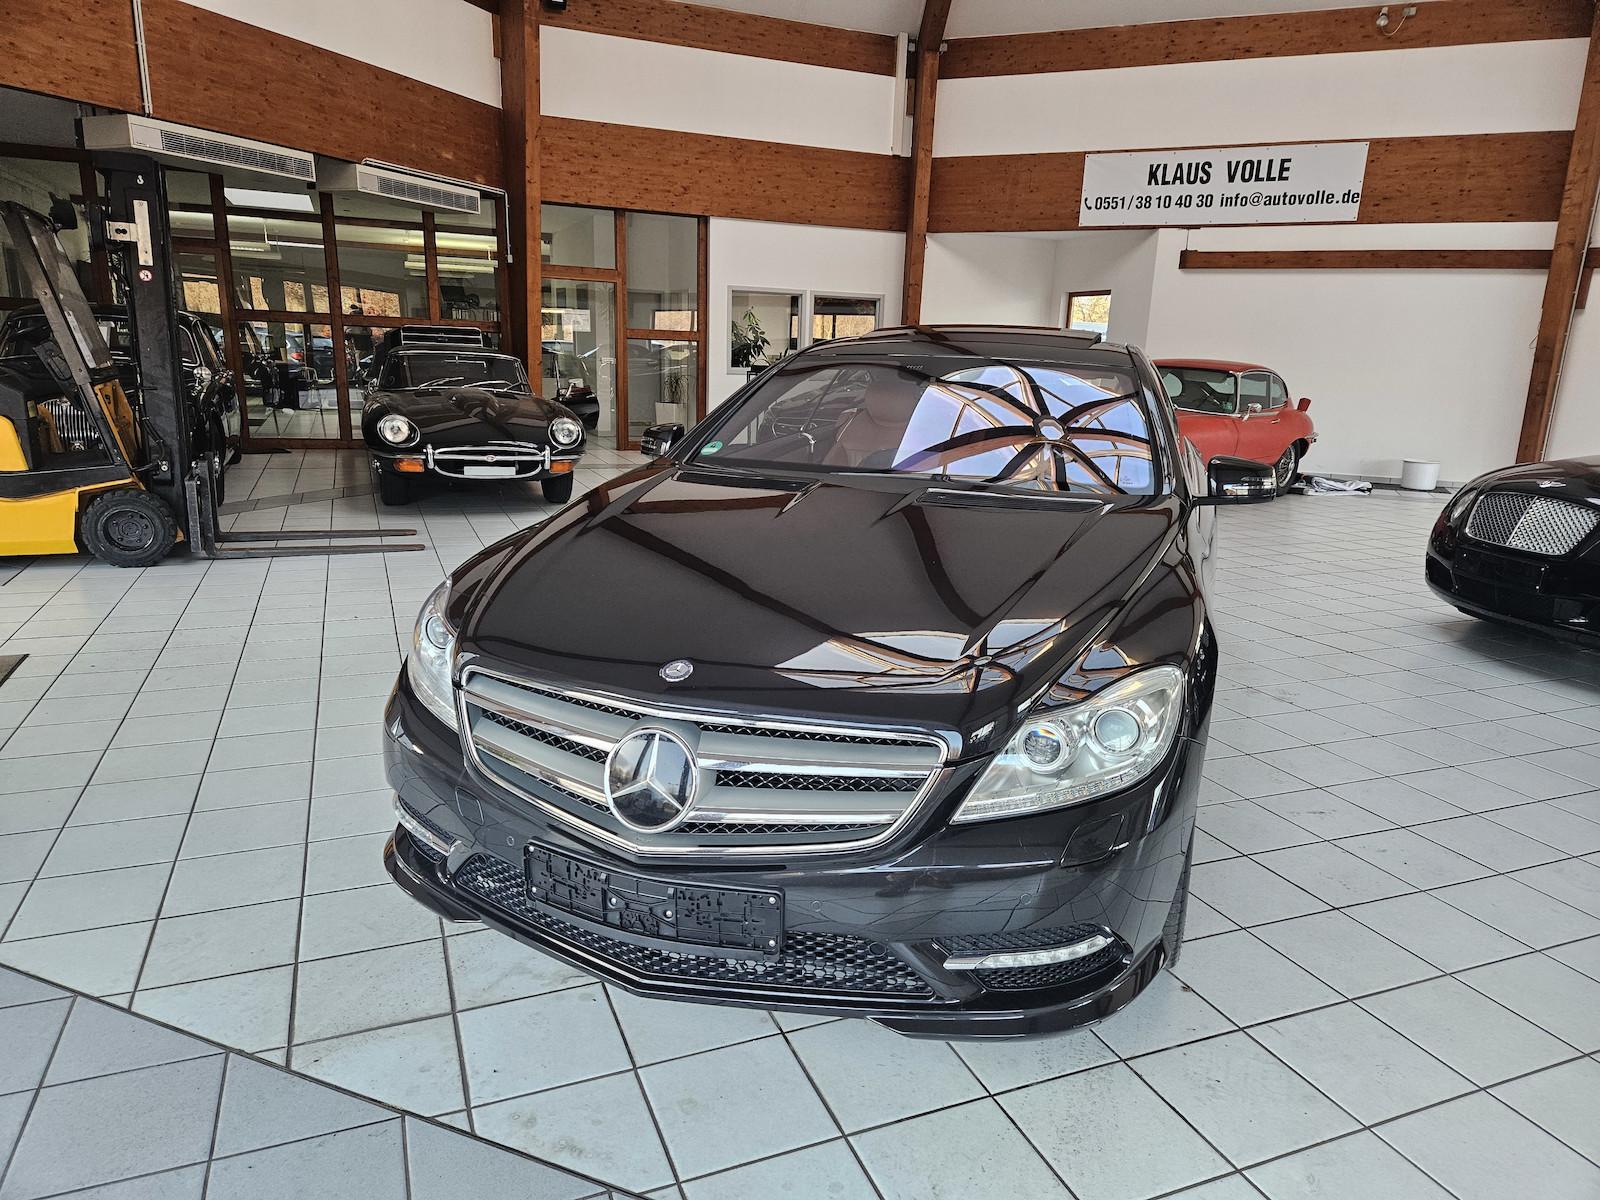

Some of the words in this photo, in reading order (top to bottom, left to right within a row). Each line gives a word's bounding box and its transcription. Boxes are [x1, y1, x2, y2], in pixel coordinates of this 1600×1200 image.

[1147, 161, 1213, 186] KLAUS
[1227, 158, 1292, 184] VOLLE
[1155, 195, 1172, 209] 10
[1174, 194, 1193, 209] 40
[1195, 193, 1214, 208] 30
[1219, 189, 1361, 208] info@autovolle.de
